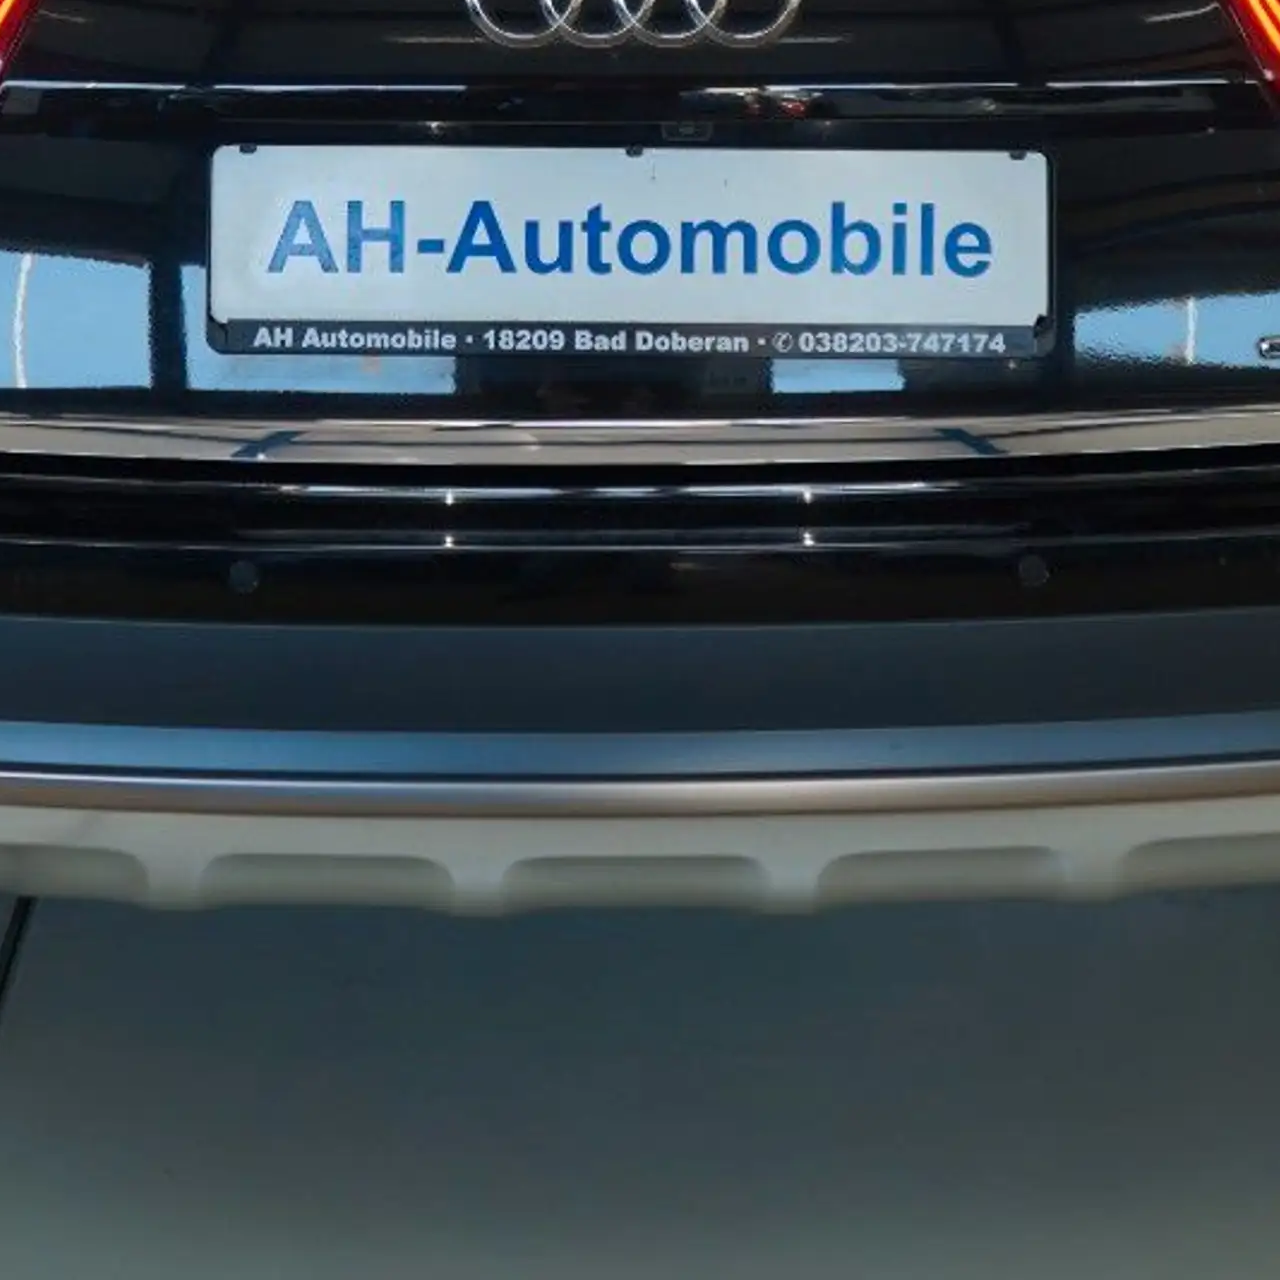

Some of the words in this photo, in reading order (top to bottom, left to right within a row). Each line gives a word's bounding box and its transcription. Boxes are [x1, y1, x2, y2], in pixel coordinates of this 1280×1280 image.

[267, 200, 993, 278] AH-Automobile
[253, 327, 294, 348] AH
[302, 326, 456, 350] Automobile
[483, 329, 565, 351] 18209
[574, 330, 627, 352] Bad
[635, 330, 749, 353] Doberan
[798, 332, 1006, 355] 038203-747174
